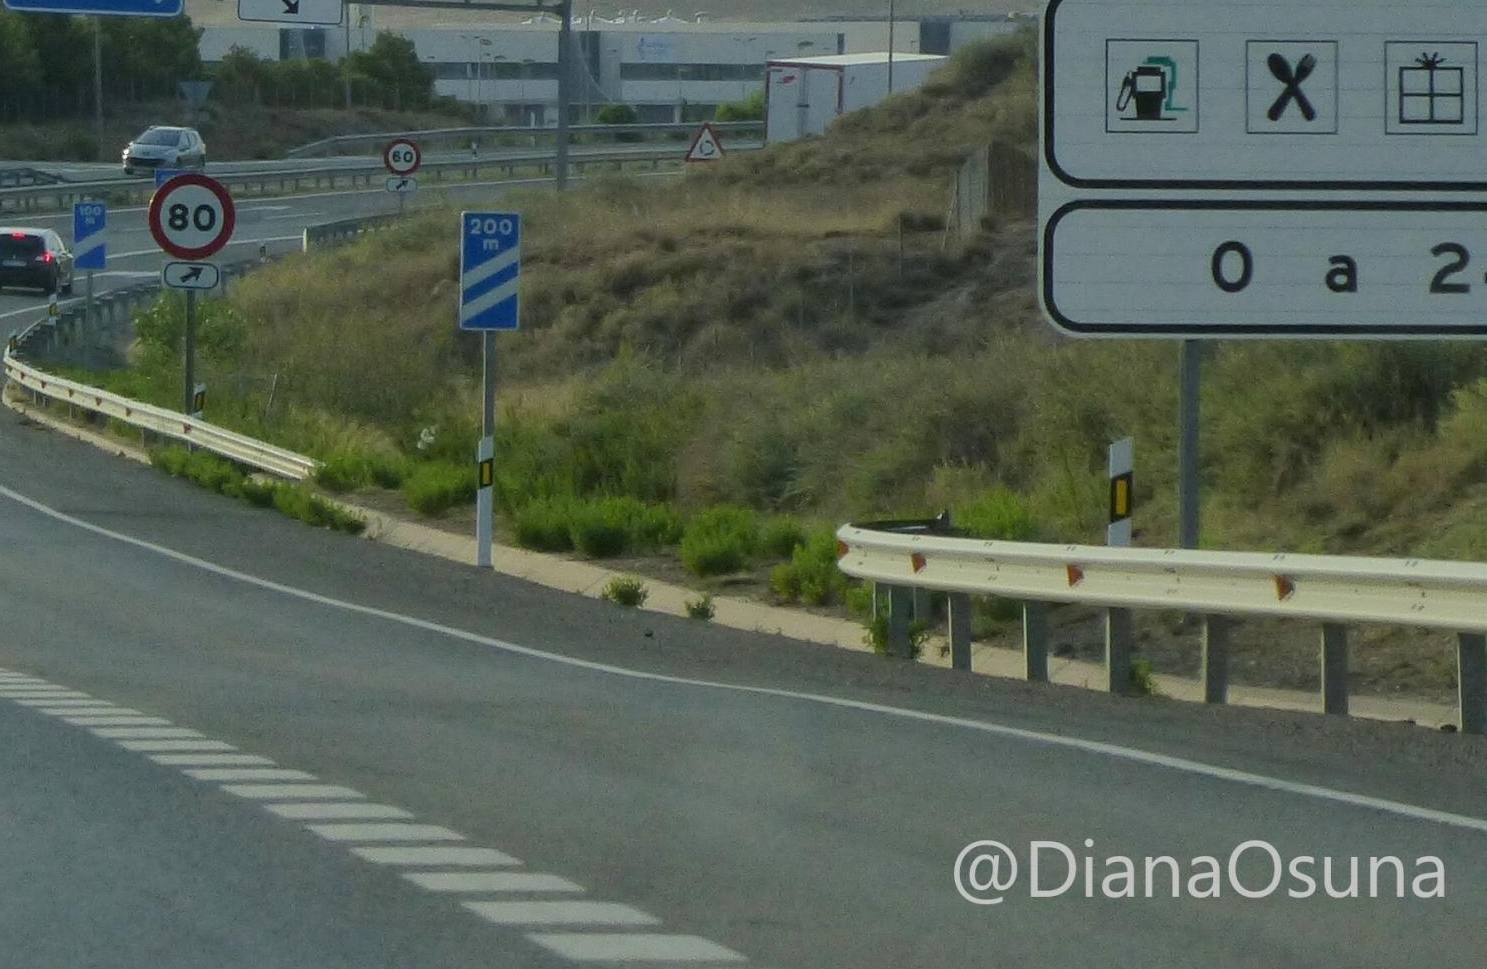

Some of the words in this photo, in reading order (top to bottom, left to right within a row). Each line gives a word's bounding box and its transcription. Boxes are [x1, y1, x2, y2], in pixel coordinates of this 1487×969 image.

[392, 150, 414, 164] 60
[79, 205, 102, 217] 100
[168, 203, 216, 232] 80
[85, 216, 96, 225] m
[470, 218, 513, 236] 200
[482, 238, 499, 251] m
[1211, 240, 1254, 293] 0
[1325, 254, 1358, 293] a
[1429, 241, 1487, 294] 2
